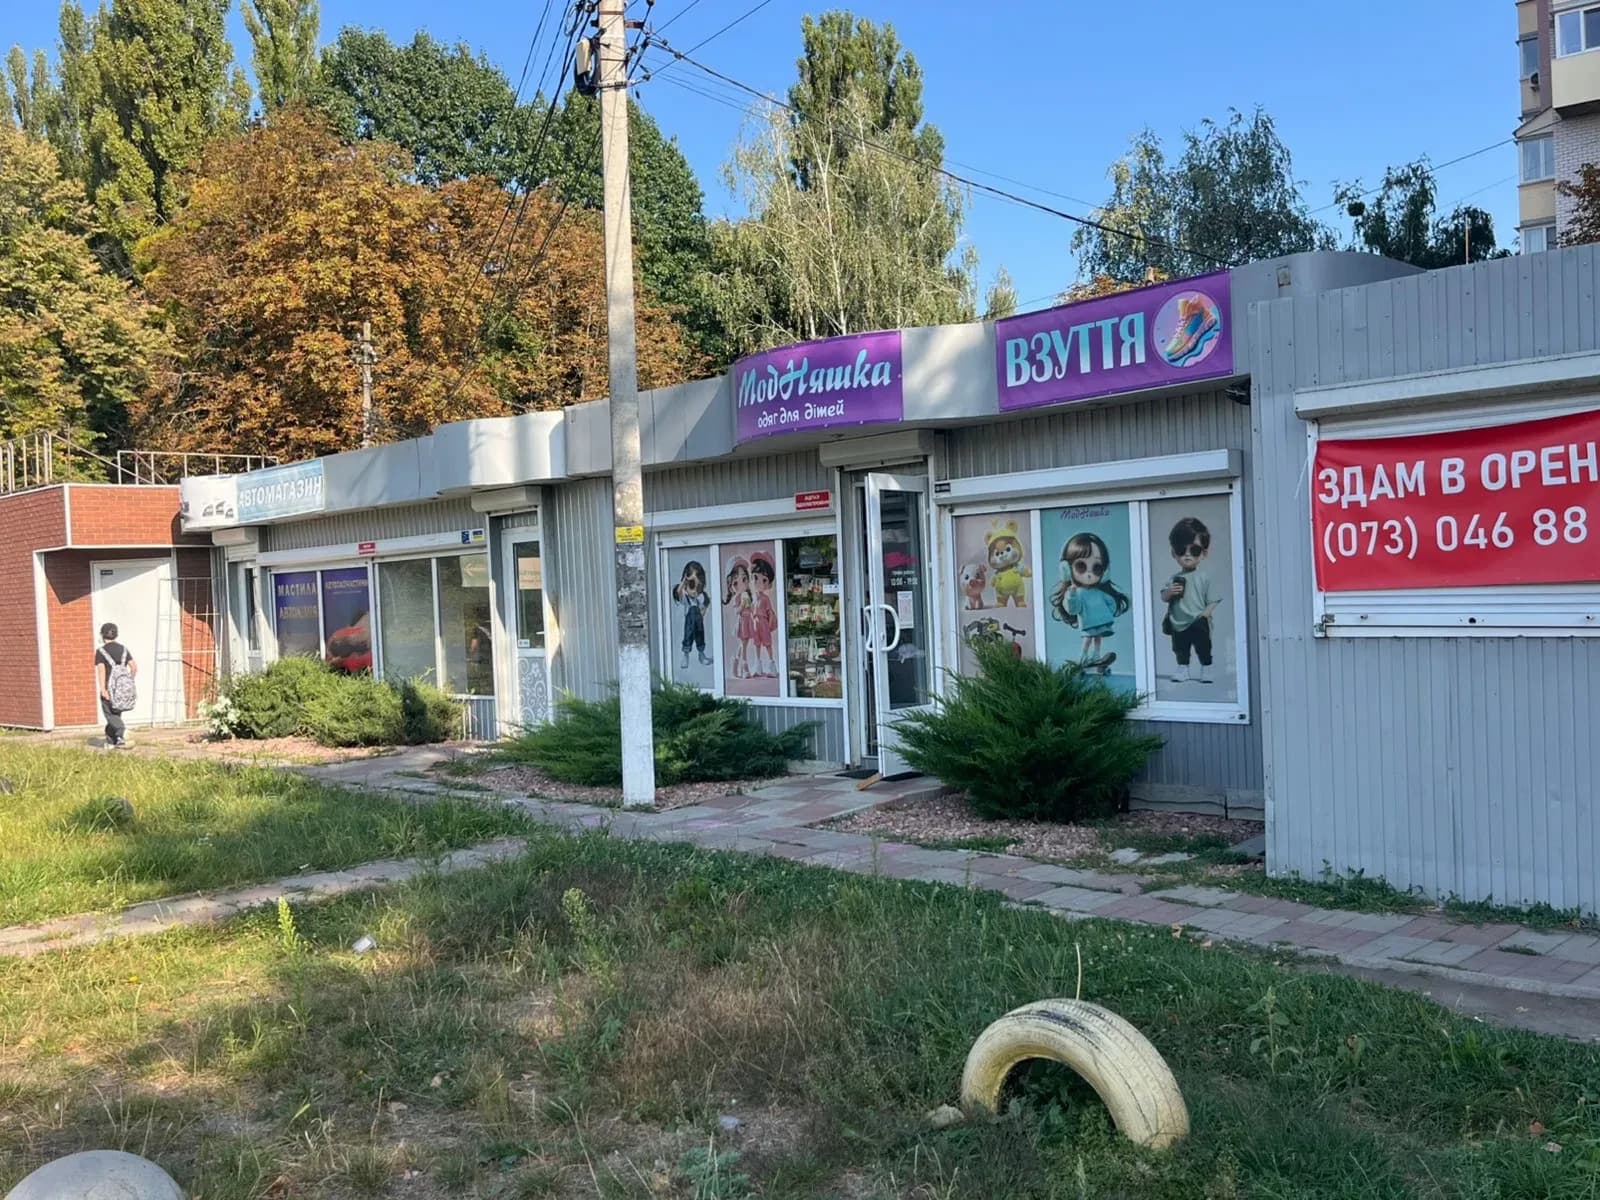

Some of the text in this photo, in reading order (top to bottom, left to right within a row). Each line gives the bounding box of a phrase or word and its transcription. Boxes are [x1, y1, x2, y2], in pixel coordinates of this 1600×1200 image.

[1006, 311, 1146, 388] ВЗУТТЯ
[738, 349, 892, 408] МодНяшка
[758, 400, 844, 428] одяг для дітей
[239, 475, 322, 508] АВТОМАГАЗИН
[1318, 441, 1599, 509] ЗДАМ В ОРЕН
[1323, 506, 1588, 563] (073) 046 88
[277, 582, 317, 597] МАСТИЛА
